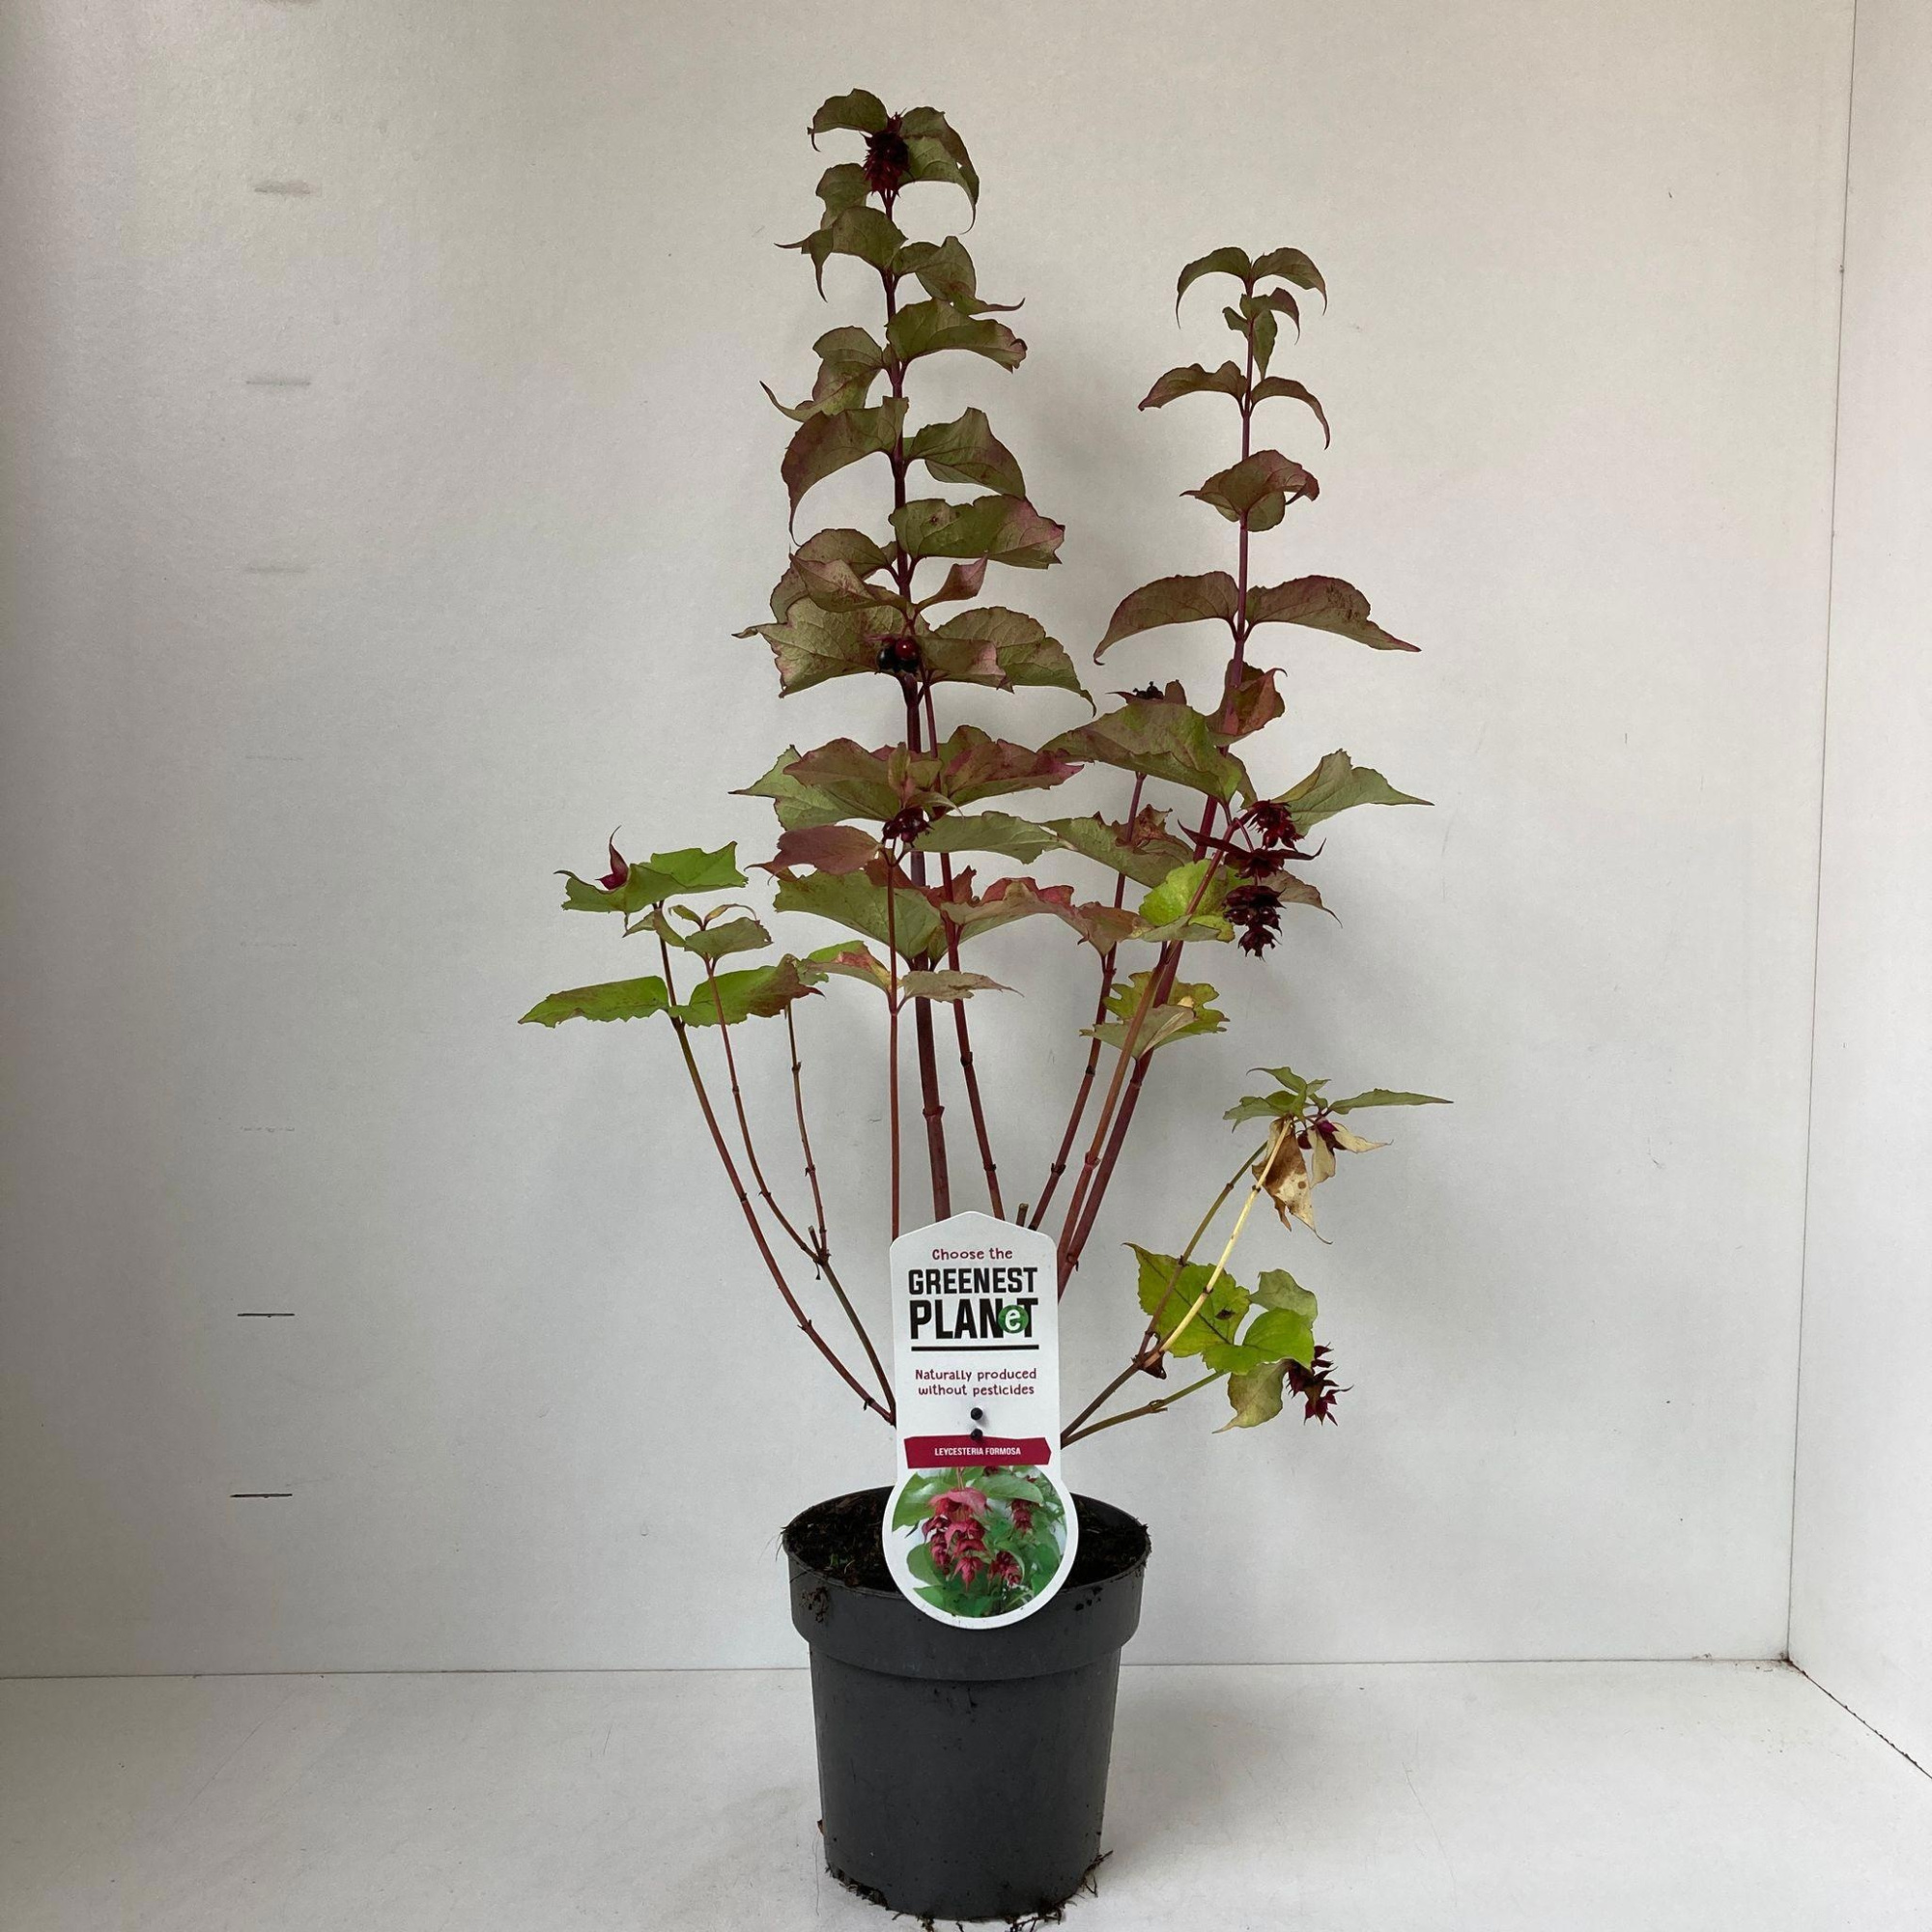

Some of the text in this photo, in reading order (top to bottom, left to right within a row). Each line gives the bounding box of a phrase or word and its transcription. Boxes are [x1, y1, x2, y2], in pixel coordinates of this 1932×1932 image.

[932, 1248, 1013, 1260] Choose the
[908, 1267, 1037, 1294] GREENEST
[915, 1368, 1037, 1382] Naturally produced
[919, 1384, 1035, 1397] without pesticides
[934, 1447, 1021, 1456] LEYCESTERIA FORMOSA
